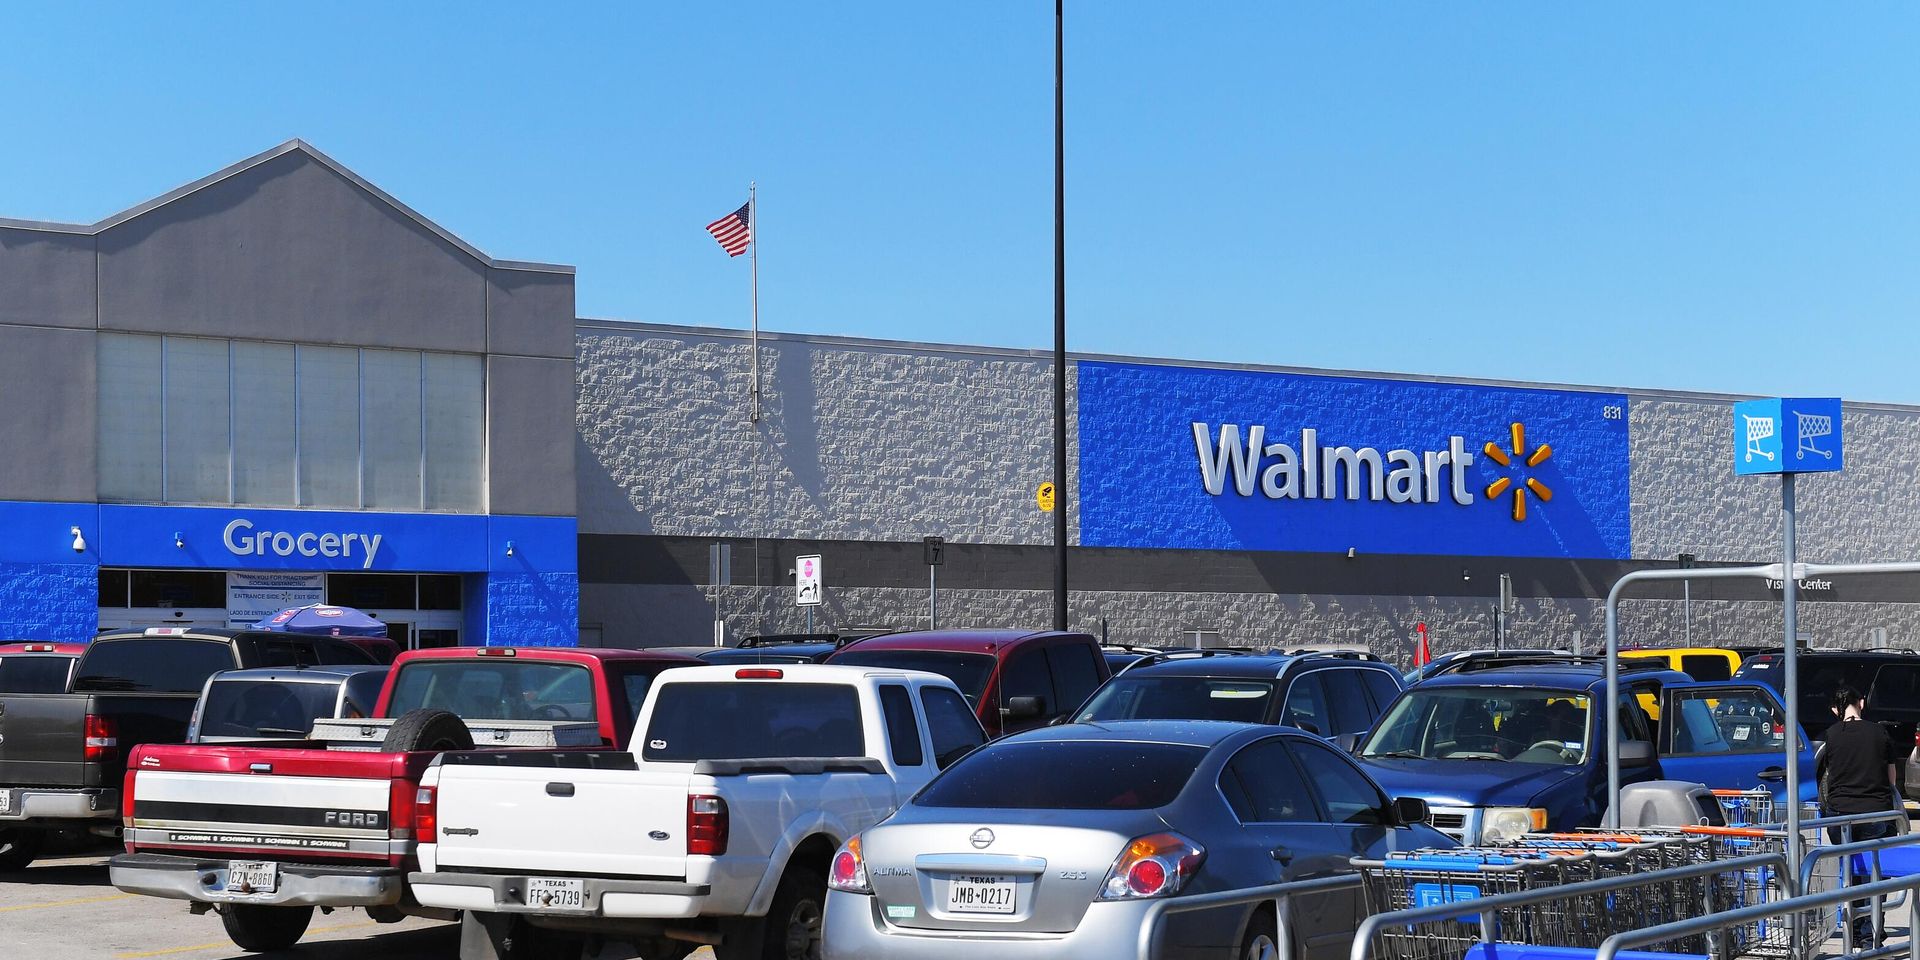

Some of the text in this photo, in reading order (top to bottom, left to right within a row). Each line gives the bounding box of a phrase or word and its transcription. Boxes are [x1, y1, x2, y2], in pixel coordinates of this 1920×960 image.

[1603, 405, 1622, 420] 831
[1192, 421, 1474, 506] Walmart
[223, 518, 383, 569] Grocery
[932, 547, 940, 562] 7
[236, 573, 257, 581] THANK
[1798, 578, 1832, 590] Center
[325, 811, 378, 825] FORD
[873, 867, 912, 877] ALTIMA
[969, 876, 996, 884] TEXAS
